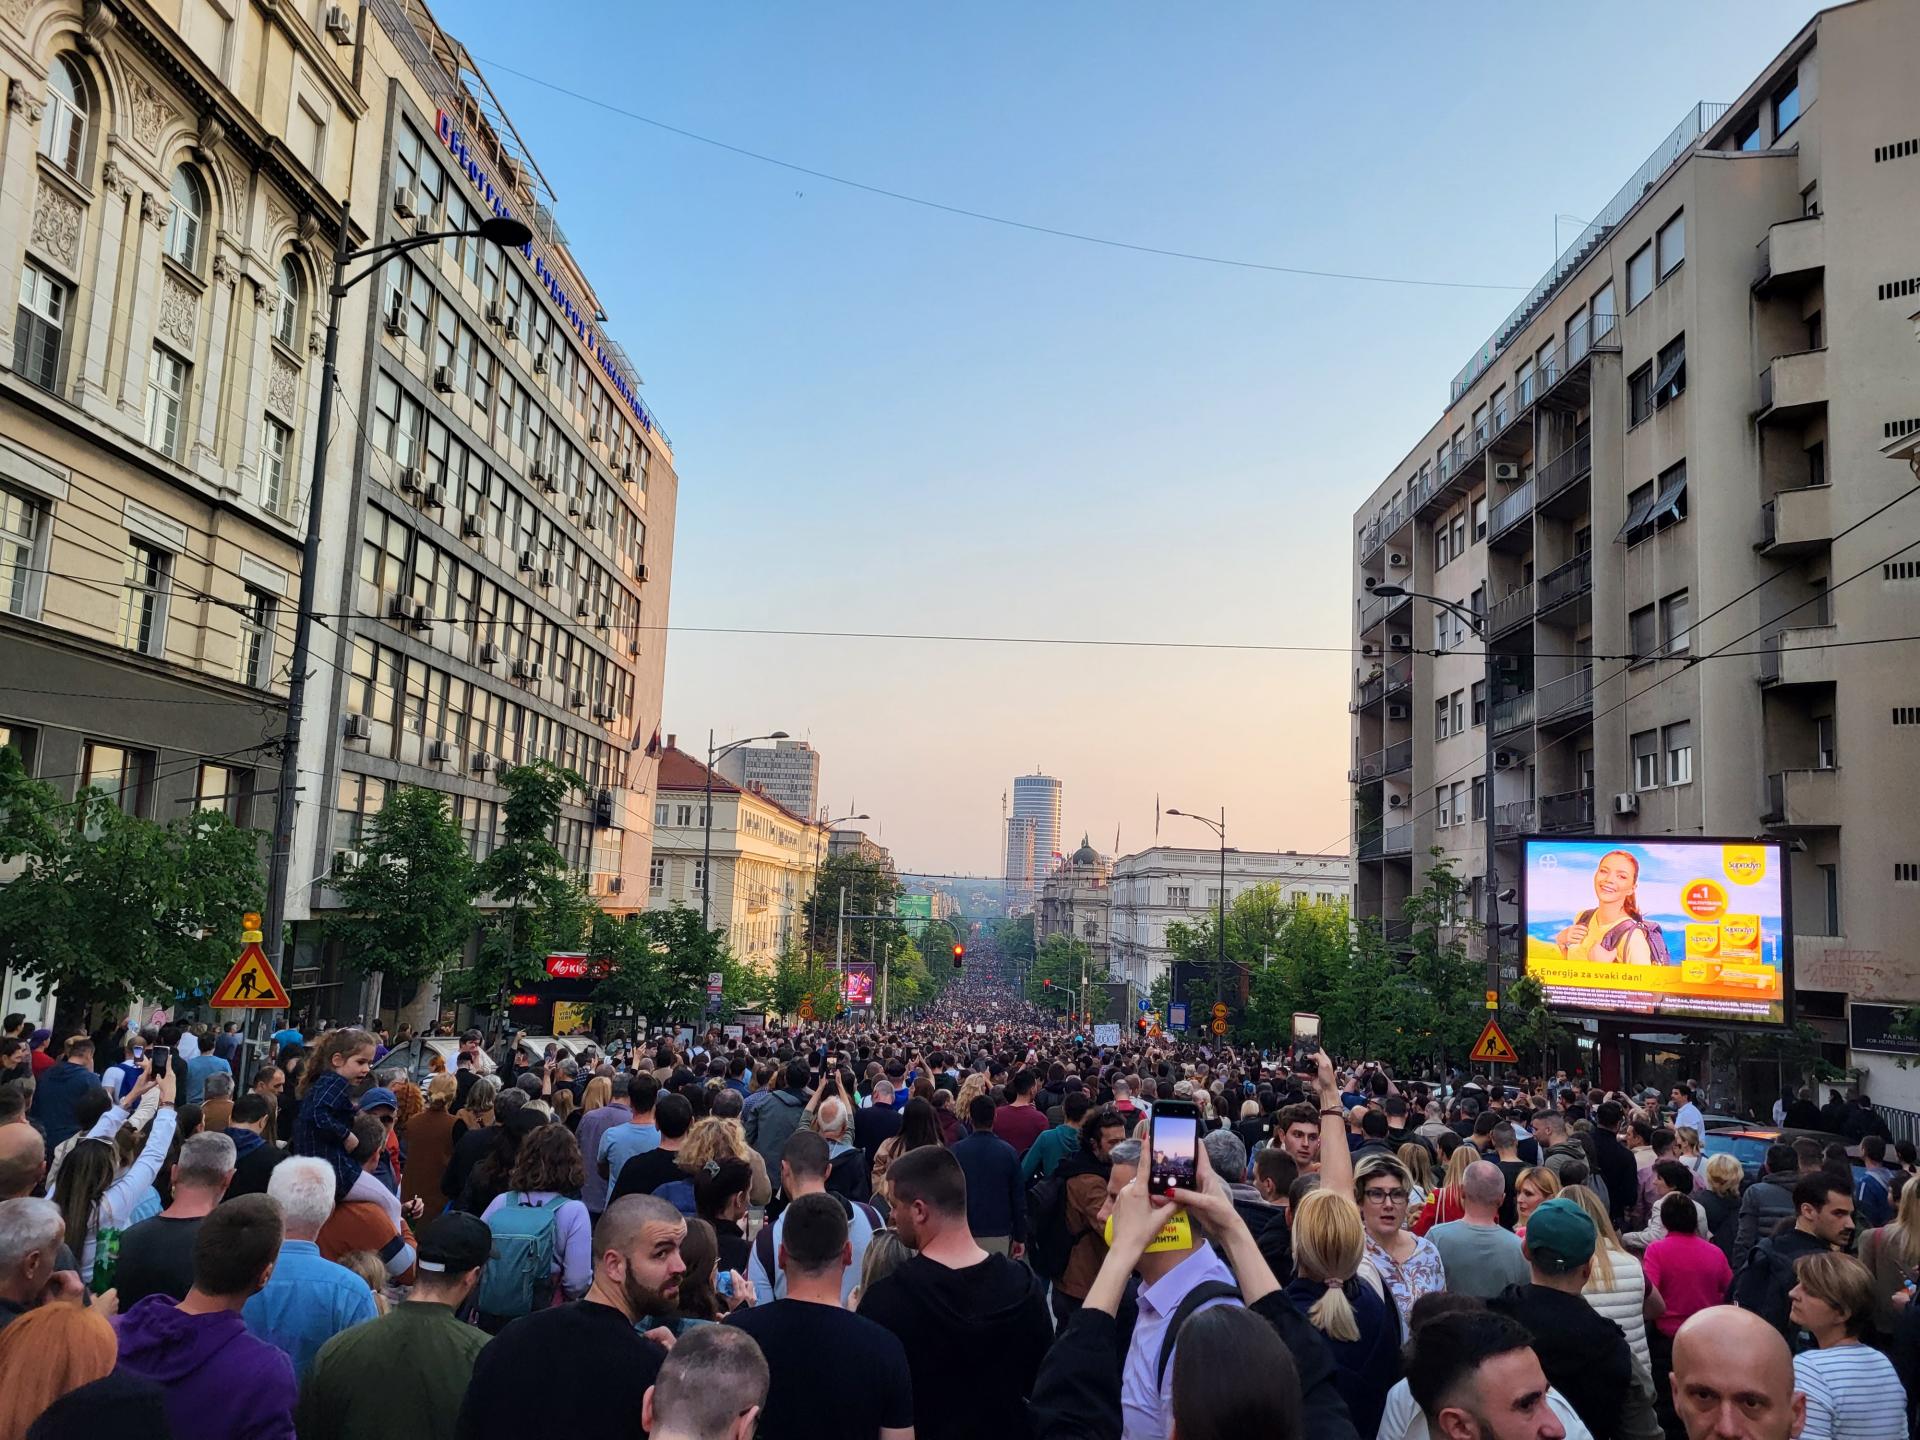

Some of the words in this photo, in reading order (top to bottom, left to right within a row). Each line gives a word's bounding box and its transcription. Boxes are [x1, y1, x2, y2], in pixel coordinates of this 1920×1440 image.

[450, 131, 533, 261] БЕОГРАИ
[1540, 968, 1578, 979] Energija
[1594, 970, 1619, 980] svaki
[1621, 971, 1642, 981] dan!
[1216, 1022, 1224, 1031] 40
